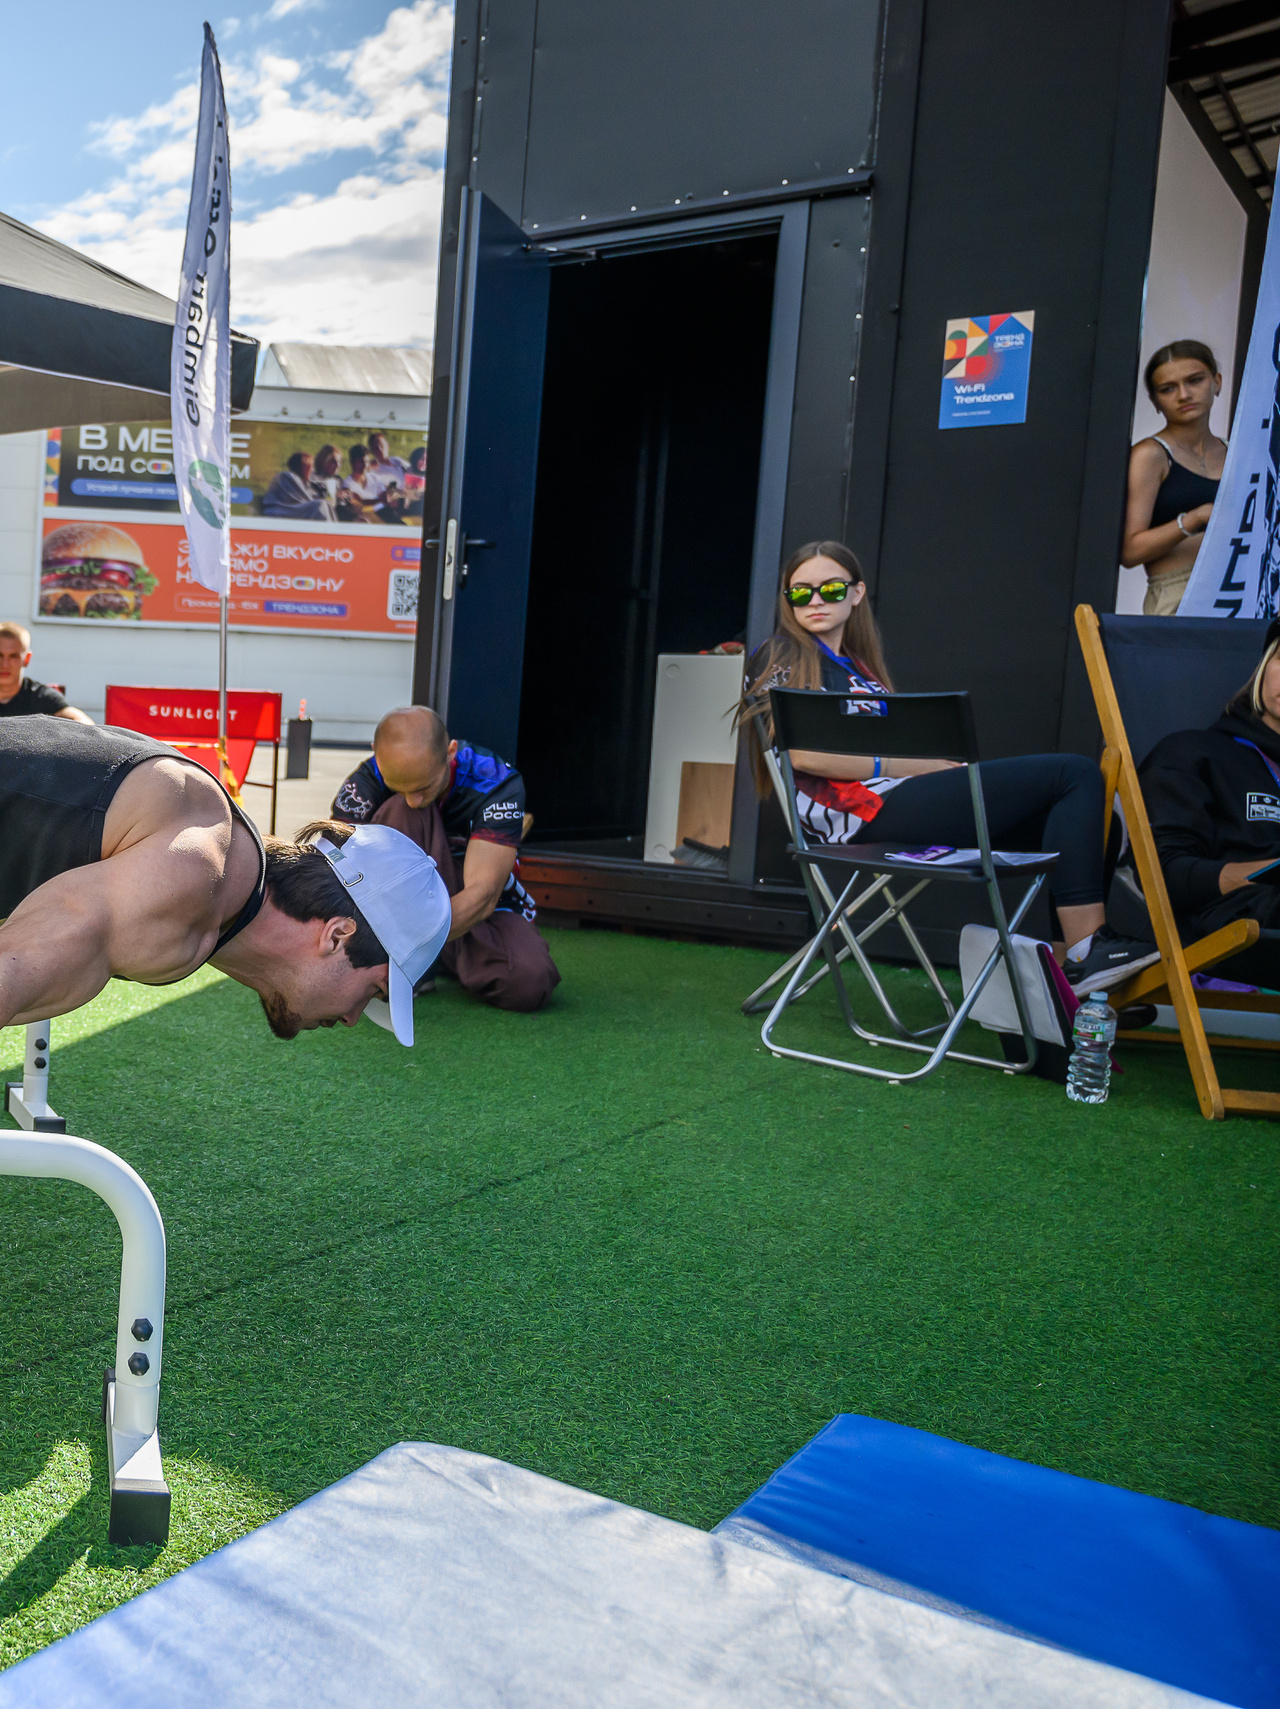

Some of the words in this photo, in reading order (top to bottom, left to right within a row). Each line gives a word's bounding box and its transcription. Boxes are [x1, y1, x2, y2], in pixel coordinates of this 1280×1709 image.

[79, 424, 108, 450] В
[117, 426, 251, 459] МЕЕ
[77, 455, 125, 474] ПОД
[272, 545, 354, 563] ВКУСНО
